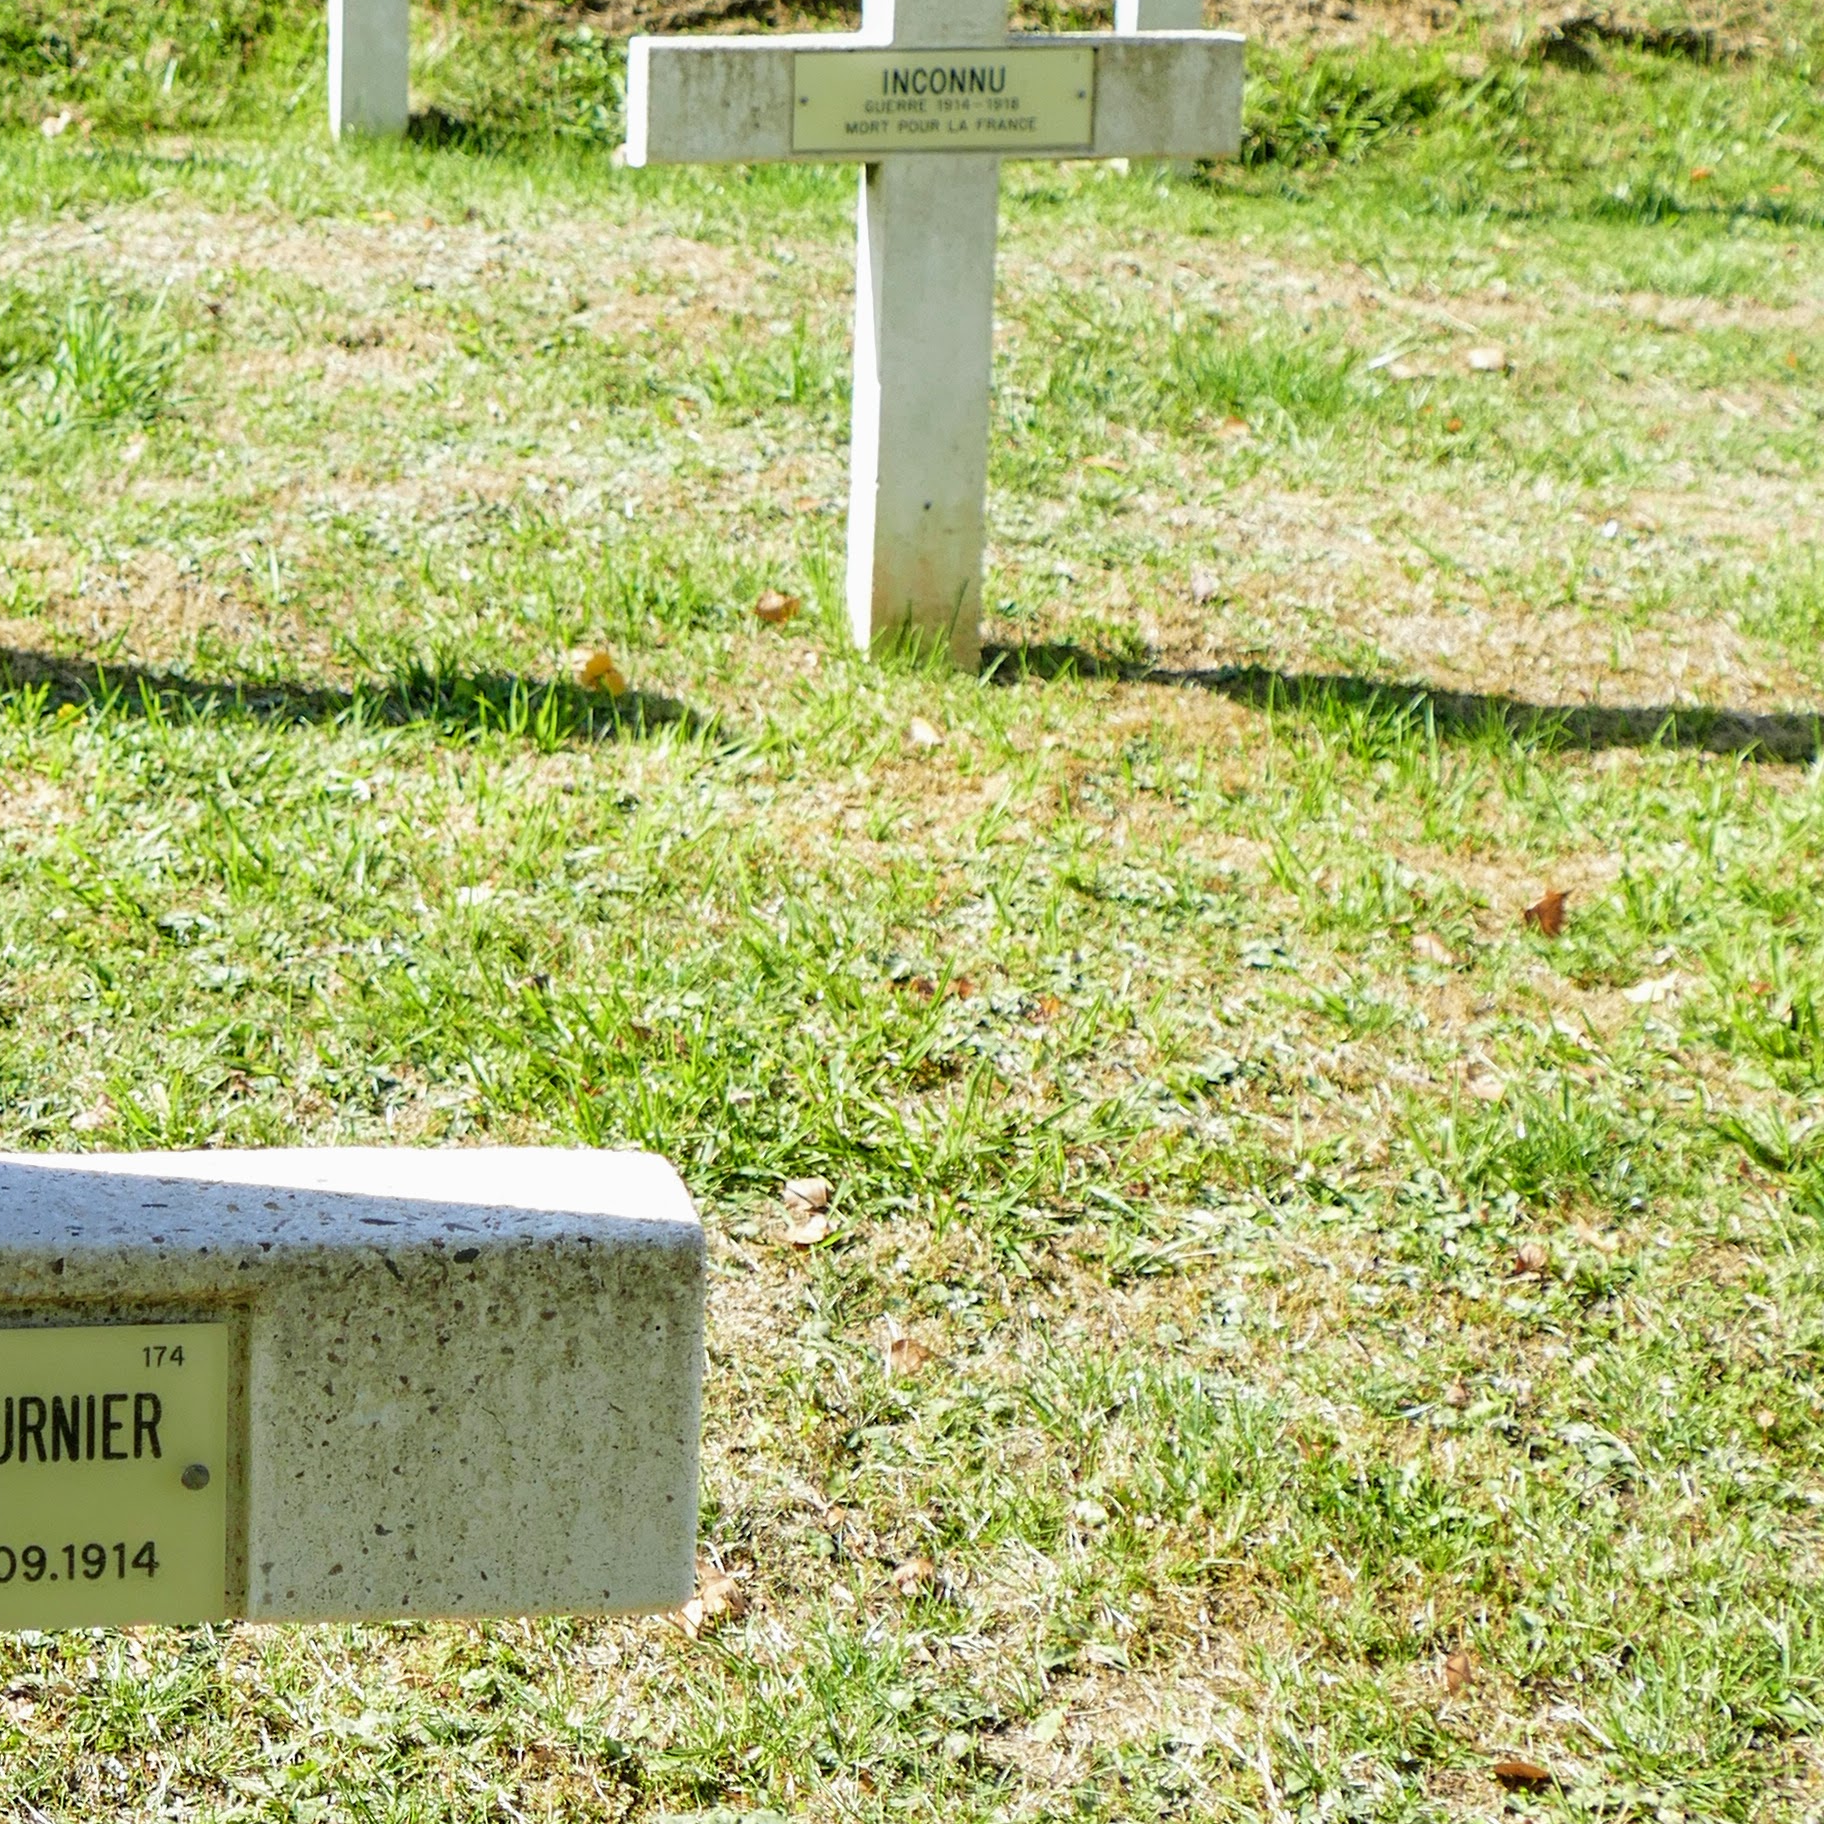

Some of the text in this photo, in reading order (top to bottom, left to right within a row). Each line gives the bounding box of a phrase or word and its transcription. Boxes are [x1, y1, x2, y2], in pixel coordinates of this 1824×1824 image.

[883, 66, 1006, 95] INCONNU
[864, 99, 927, 114] GUERRE
[845, 116, 1037, 135] MORT POUR LA FRANCE
[142, 1345, 185, 1367] 174
